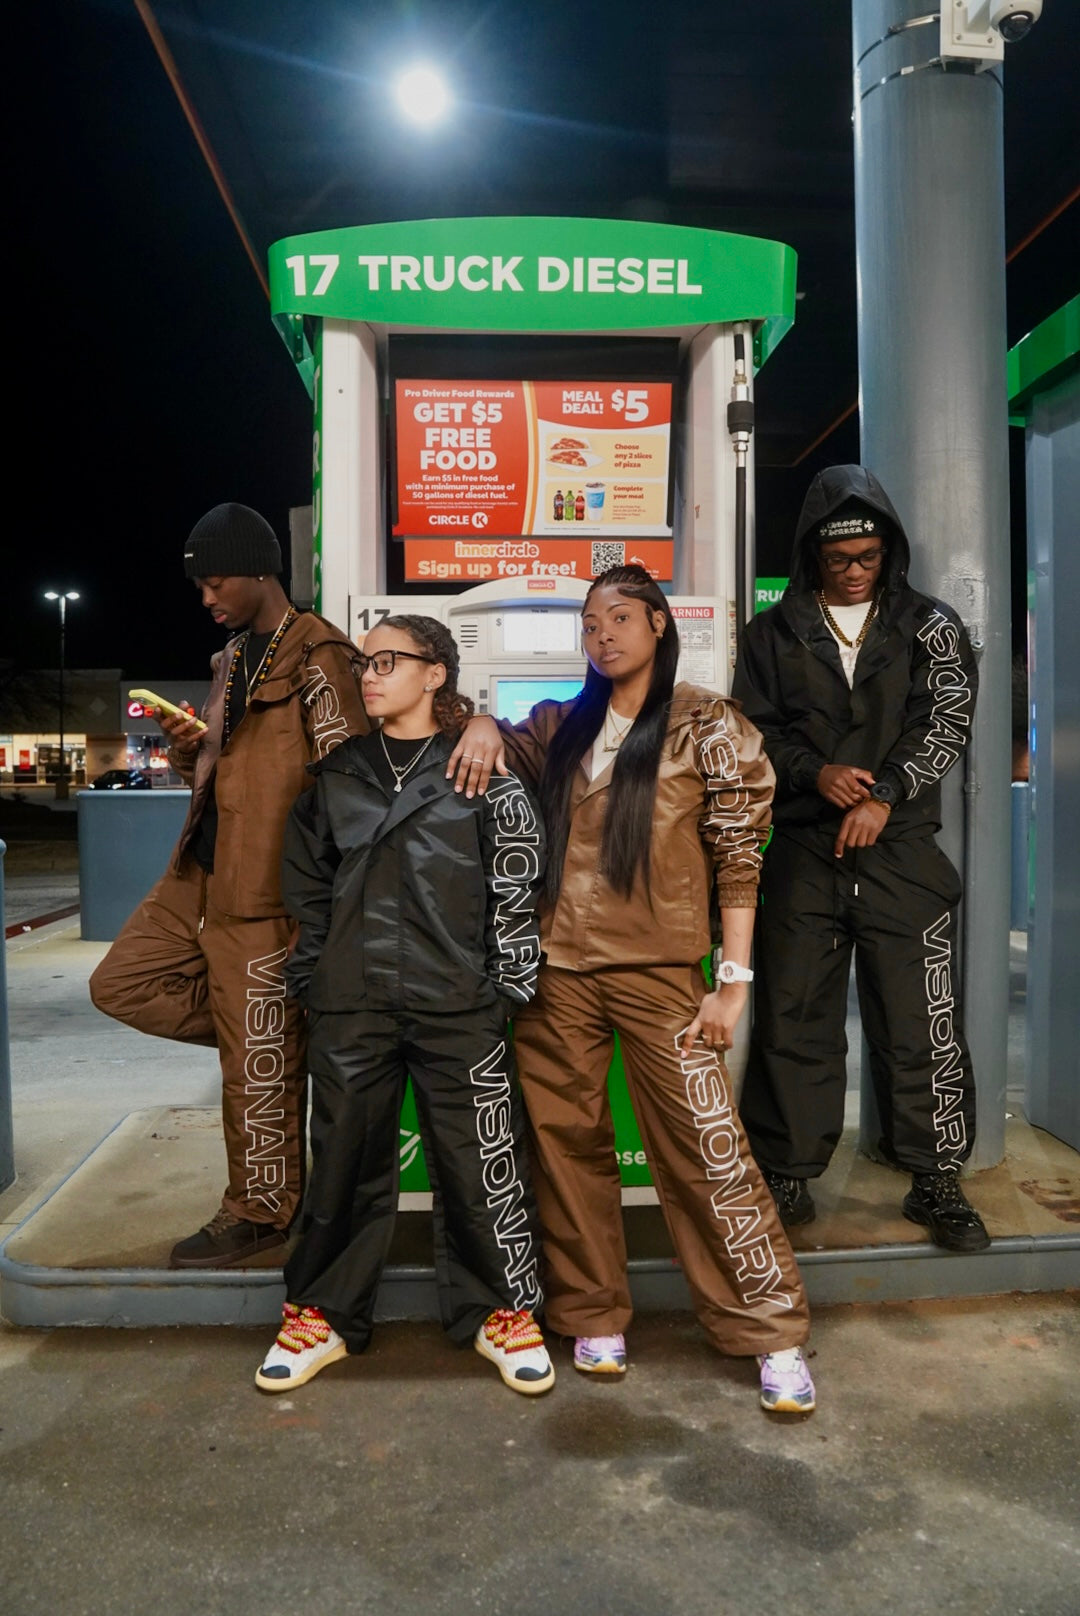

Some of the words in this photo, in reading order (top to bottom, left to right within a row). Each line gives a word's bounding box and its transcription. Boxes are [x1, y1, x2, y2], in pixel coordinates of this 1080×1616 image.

[285, 254, 339, 296] 17
[359, 255, 524, 292] TRUCK
[538, 258, 703, 295] DIESEL
[404, 389, 421, 398] Pro
[422, 388, 451, 398] Driver
[451, 389, 475, 398] Food
[476, 390, 515, 399] Rewards
[562, 390, 603, 402] MEAL
[562, 402, 604, 415] DEAL!
[611, 389, 649, 423] $5
[413, 402, 467, 423] GET
[471, 400, 503, 426] $5
[425, 427, 492, 448] FREE
[420, 449, 497, 471] FOOD
[634, 452, 653, 460] slices
[422, 474, 441, 482] Earn
[441, 474, 452, 483] $5
[453, 474, 461, 482] in
[461, 474, 478, 482] free
[479, 474, 499, 482] food
[405, 483, 424, 491] with
[431, 483, 469, 491] minimum
[469, 483, 506, 493] purchase
[506, 483, 516, 491] of
[613, 485, 643, 493] Complete
[412, 491, 423, 499] 50
[424, 491, 454, 500] gallons
[454, 491, 464, 499] of
[465, 491, 489, 499] diesel
[489, 491, 508, 499] fuel.
[428, 515, 470, 525] CIRCLE
[472, 512, 489, 529] K
[455, 541, 540, 558] innercircle
[418, 560, 462, 578] Sign
[467, 562, 492, 578] up
[497, 560, 527, 575] for
[531, 560, 577, 576] free!
[357, 608, 391, 631] 17
[671, 608, 711, 618] ARNING
[495, 617, 502, 627] $
